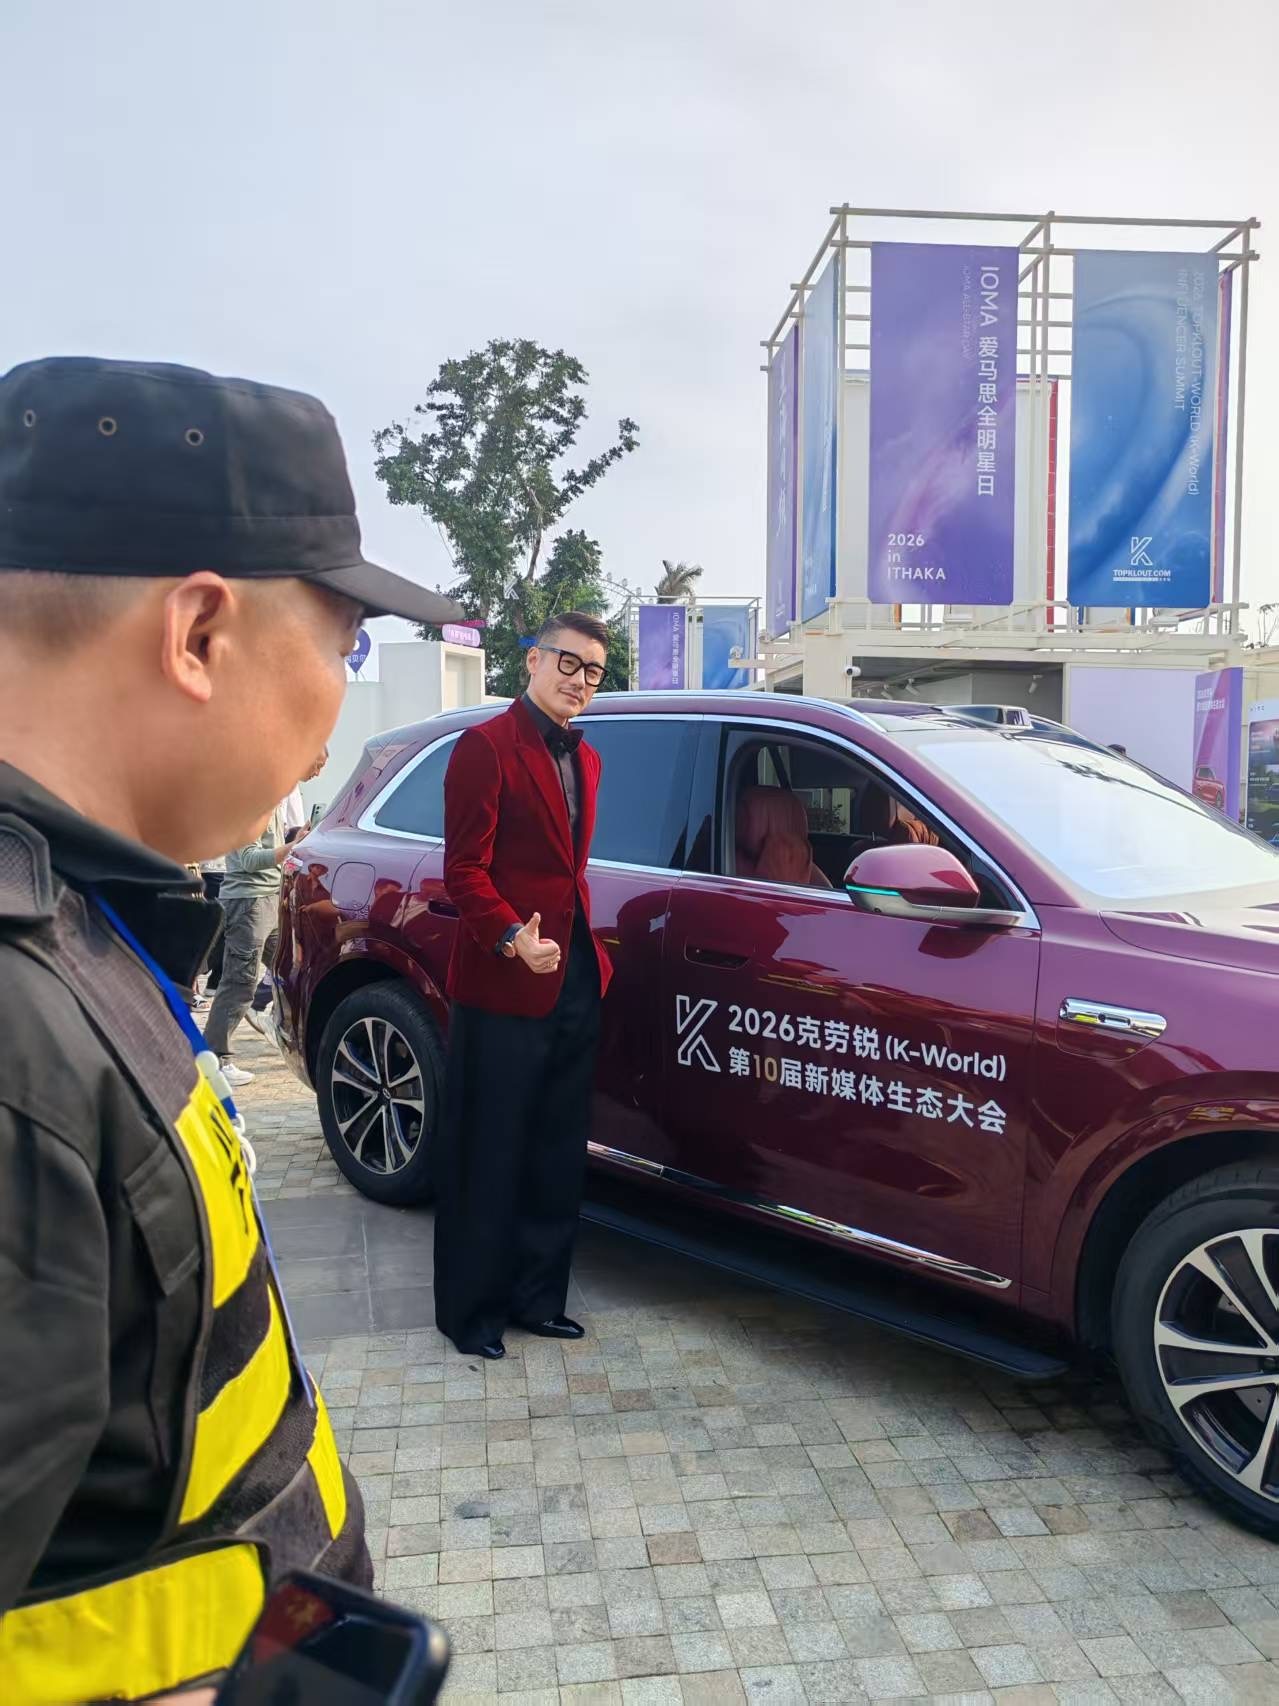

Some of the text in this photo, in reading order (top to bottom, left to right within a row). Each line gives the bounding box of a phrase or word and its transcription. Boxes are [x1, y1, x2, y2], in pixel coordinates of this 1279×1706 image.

[977, 266, 999, 496] IOMA 爱马思全明星日
[1175, 357, 1186, 412] SUMMIT
[887, 533, 925, 546] 2026
[887, 549, 901, 563] in
[887, 567, 946, 580] ITHAKA
[1112, 569, 1171, 577] TOPKLOUT.COM
[728, 1005, 1006, 1081] 2026克劳锐 (K-World)
[728, 1046, 1007, 1134] 第10届新媒体生态大会
